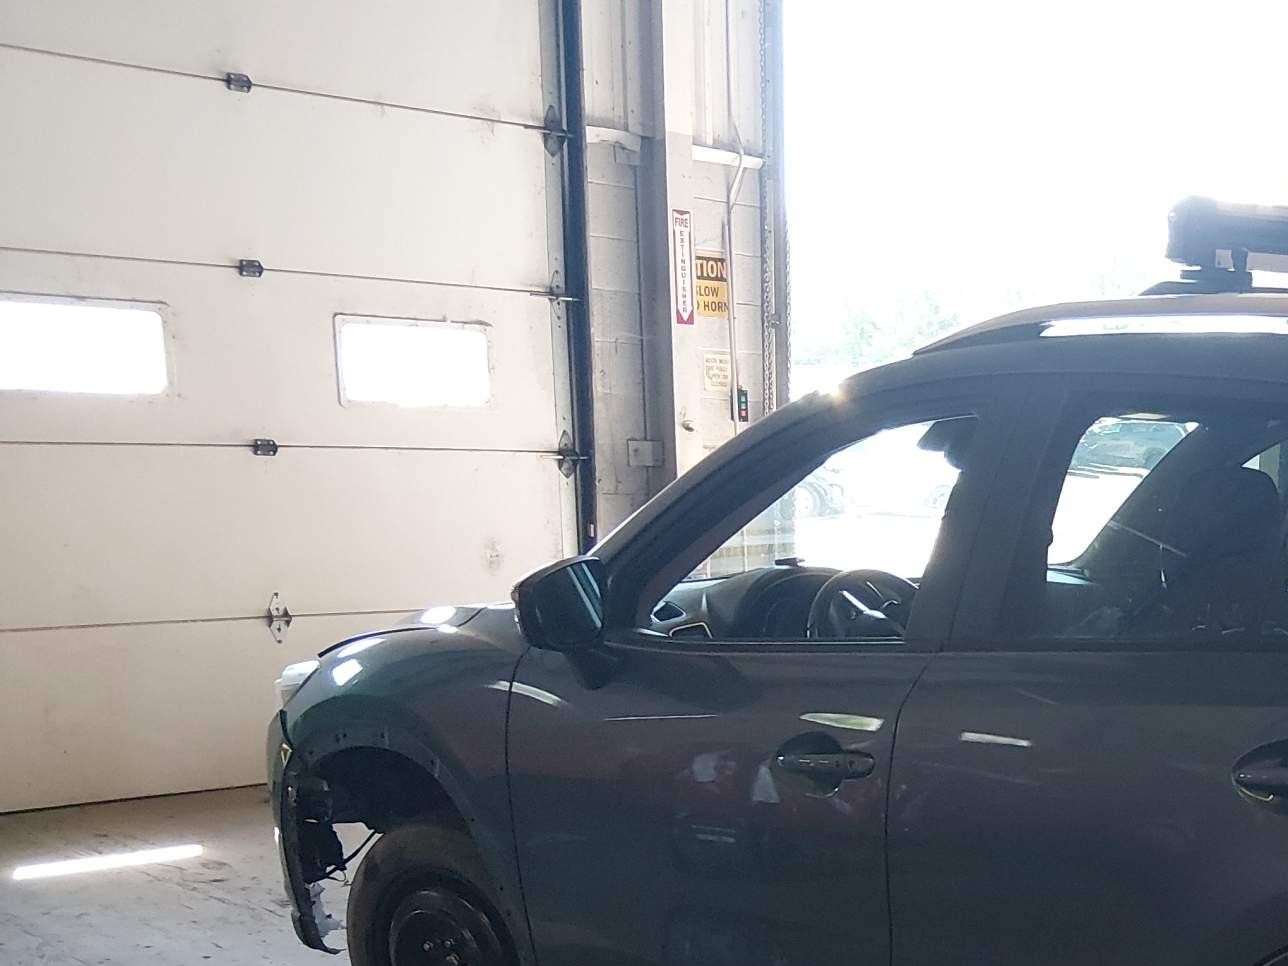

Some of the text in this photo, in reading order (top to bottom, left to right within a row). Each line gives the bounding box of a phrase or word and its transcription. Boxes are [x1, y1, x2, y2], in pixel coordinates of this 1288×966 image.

[674, 217, 689, 228] FIRE
[679, 231, 688, 313] EXTINGUISHER
[696, 259, 727, 278] TION
